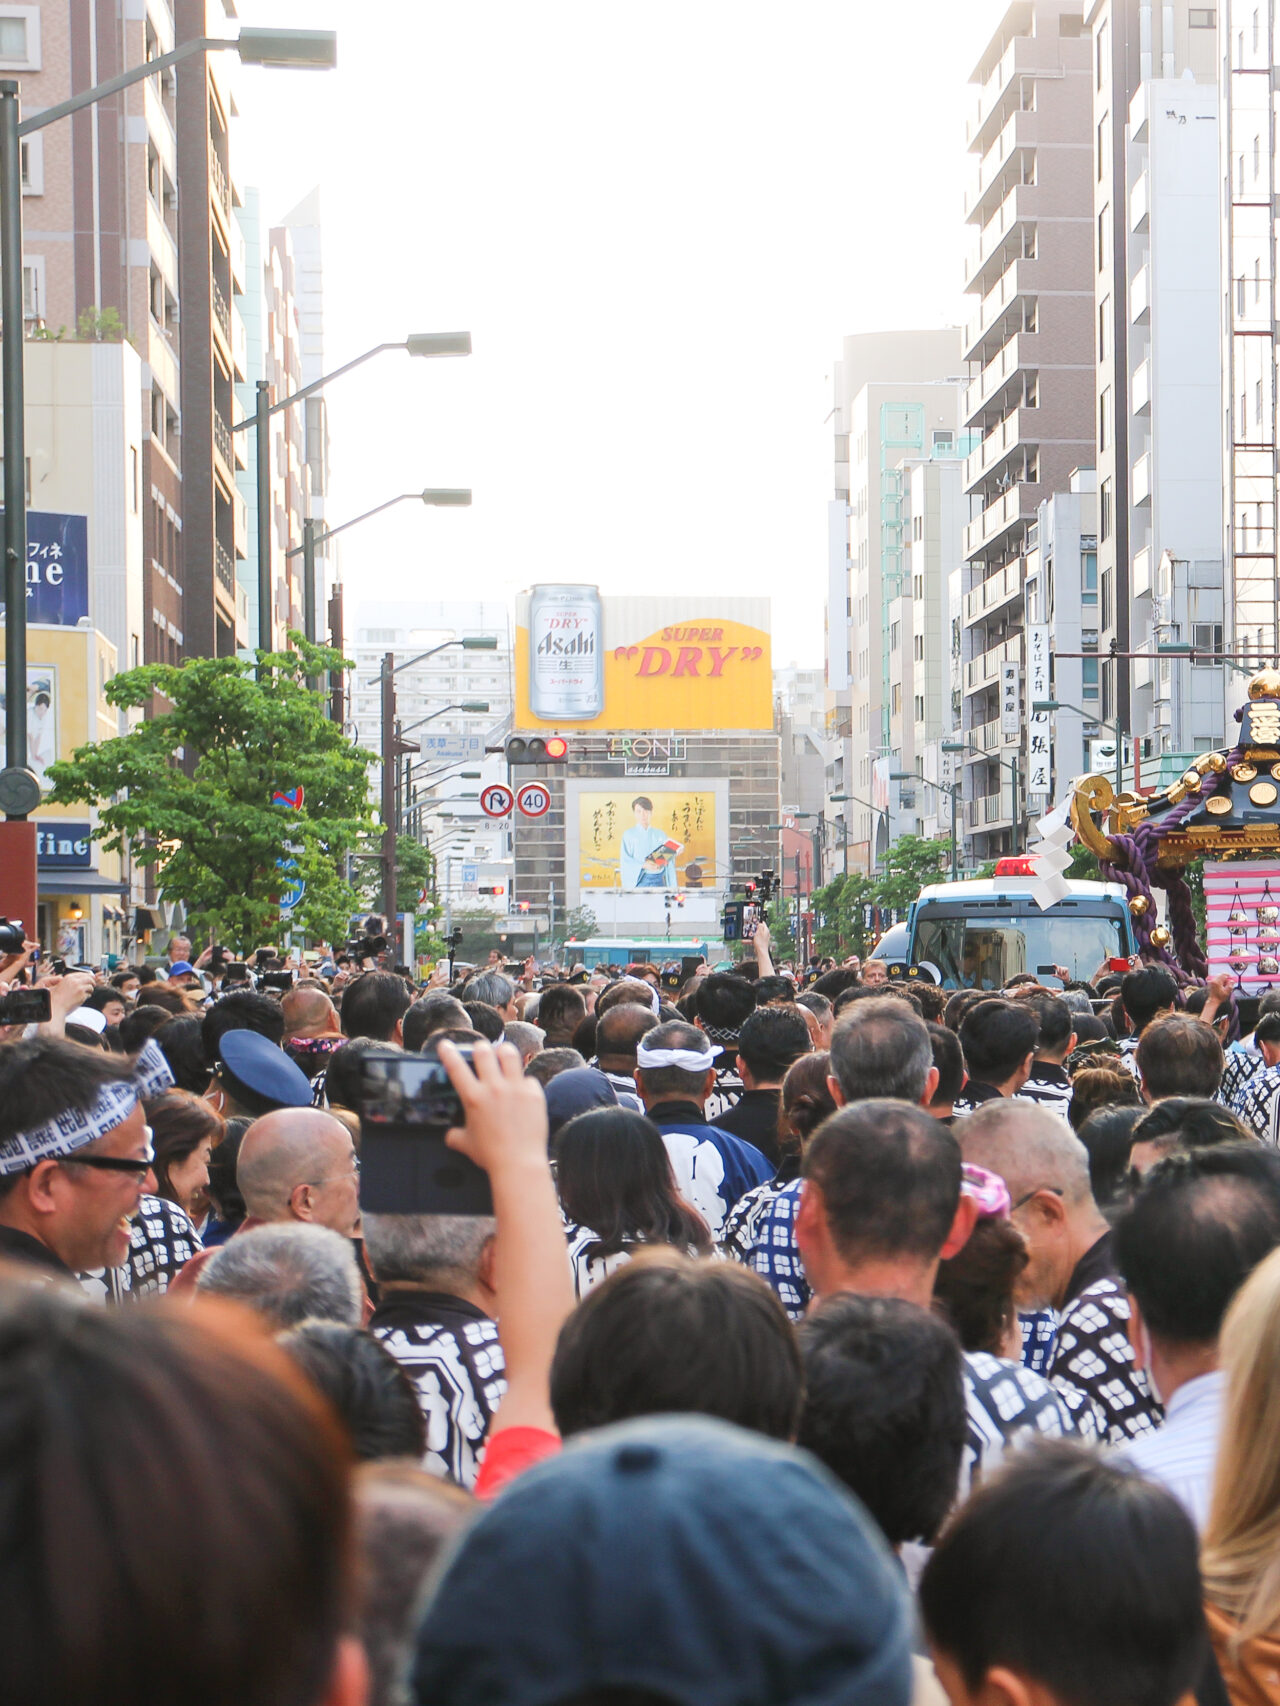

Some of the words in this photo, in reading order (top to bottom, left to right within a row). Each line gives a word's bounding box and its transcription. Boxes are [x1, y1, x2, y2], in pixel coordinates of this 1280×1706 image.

[661, 627, 724, 642] SUPER
[537, 631, 594, 656] Asahi
[426, 737, 479, 749] 浅草一丁目
[611, 738, 682, 757] FRONT
[627, 763, 667, 773] asakusa
[523, 793, 543, 807] 40
